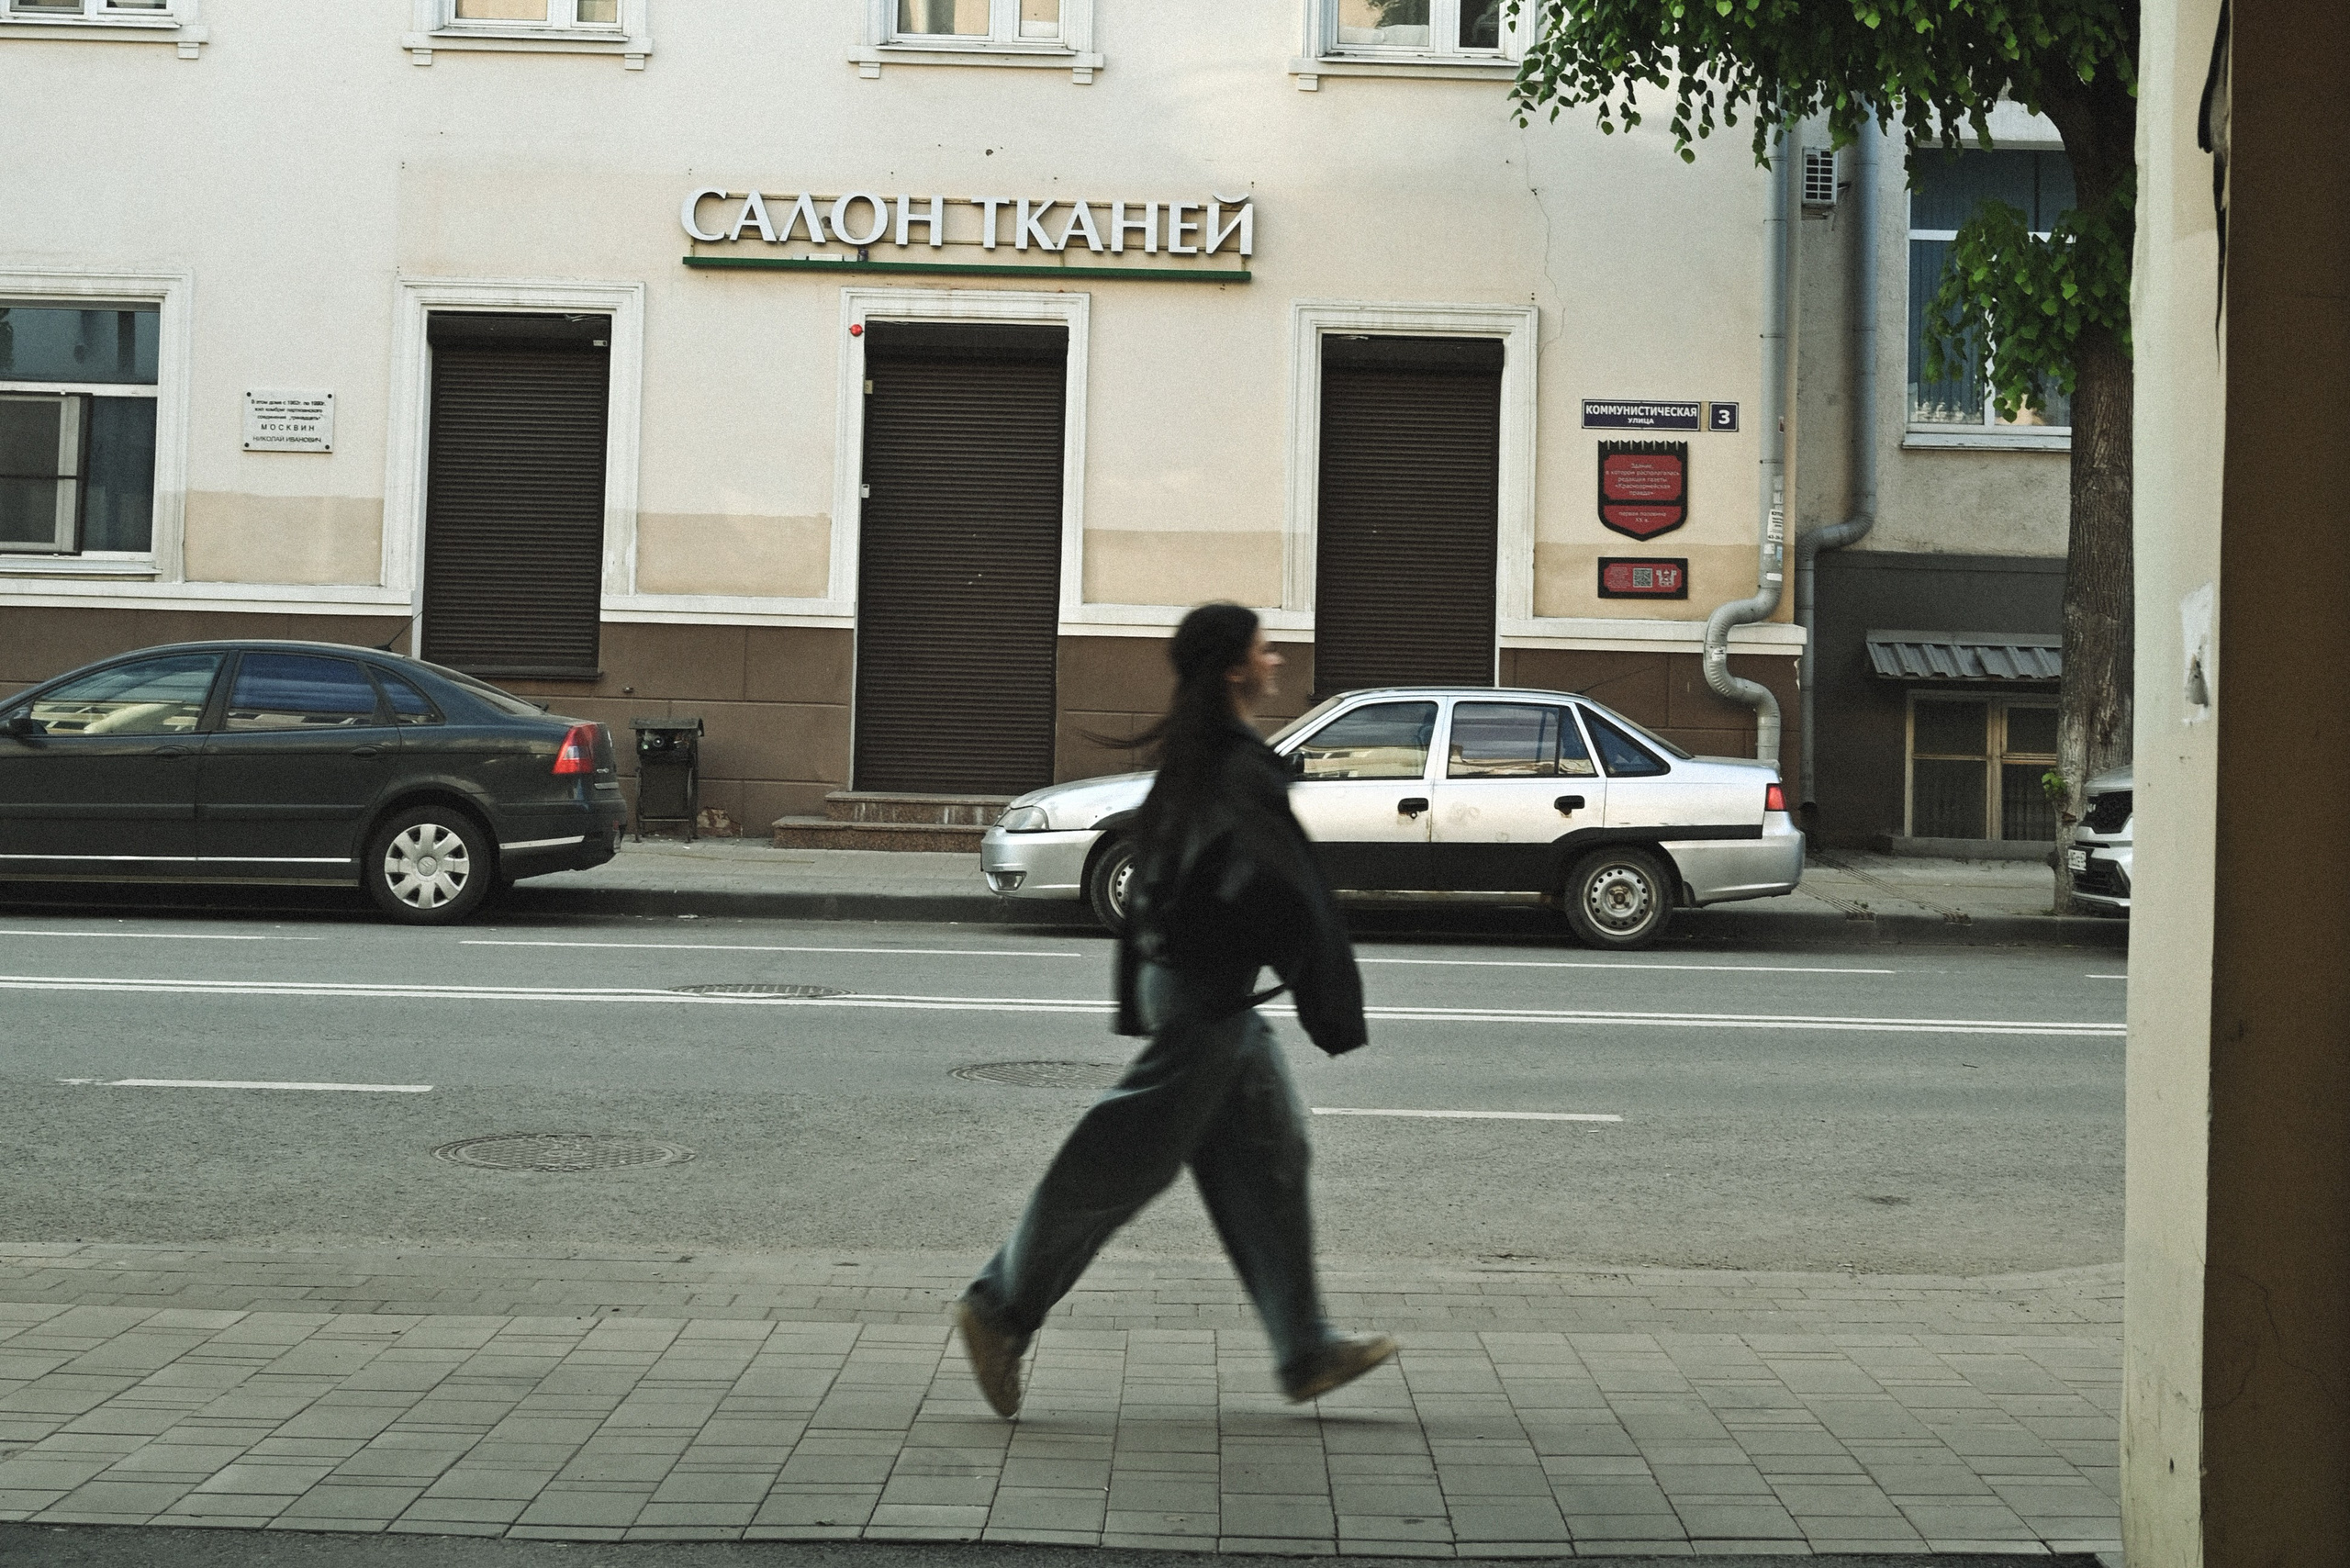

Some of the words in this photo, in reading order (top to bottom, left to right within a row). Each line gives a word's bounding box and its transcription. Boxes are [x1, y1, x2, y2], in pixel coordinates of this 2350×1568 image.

[680, 188, 943, 247] САЛОН
[970, 192, 1254, 255] ТКАНЕЙ
[1585, 404, 1697, 417] КОММУНИСТИЧЕСКАЯ
[1718, 409, 1730, 424] 3
[261, 423, 315, 431] МОСКВИН
